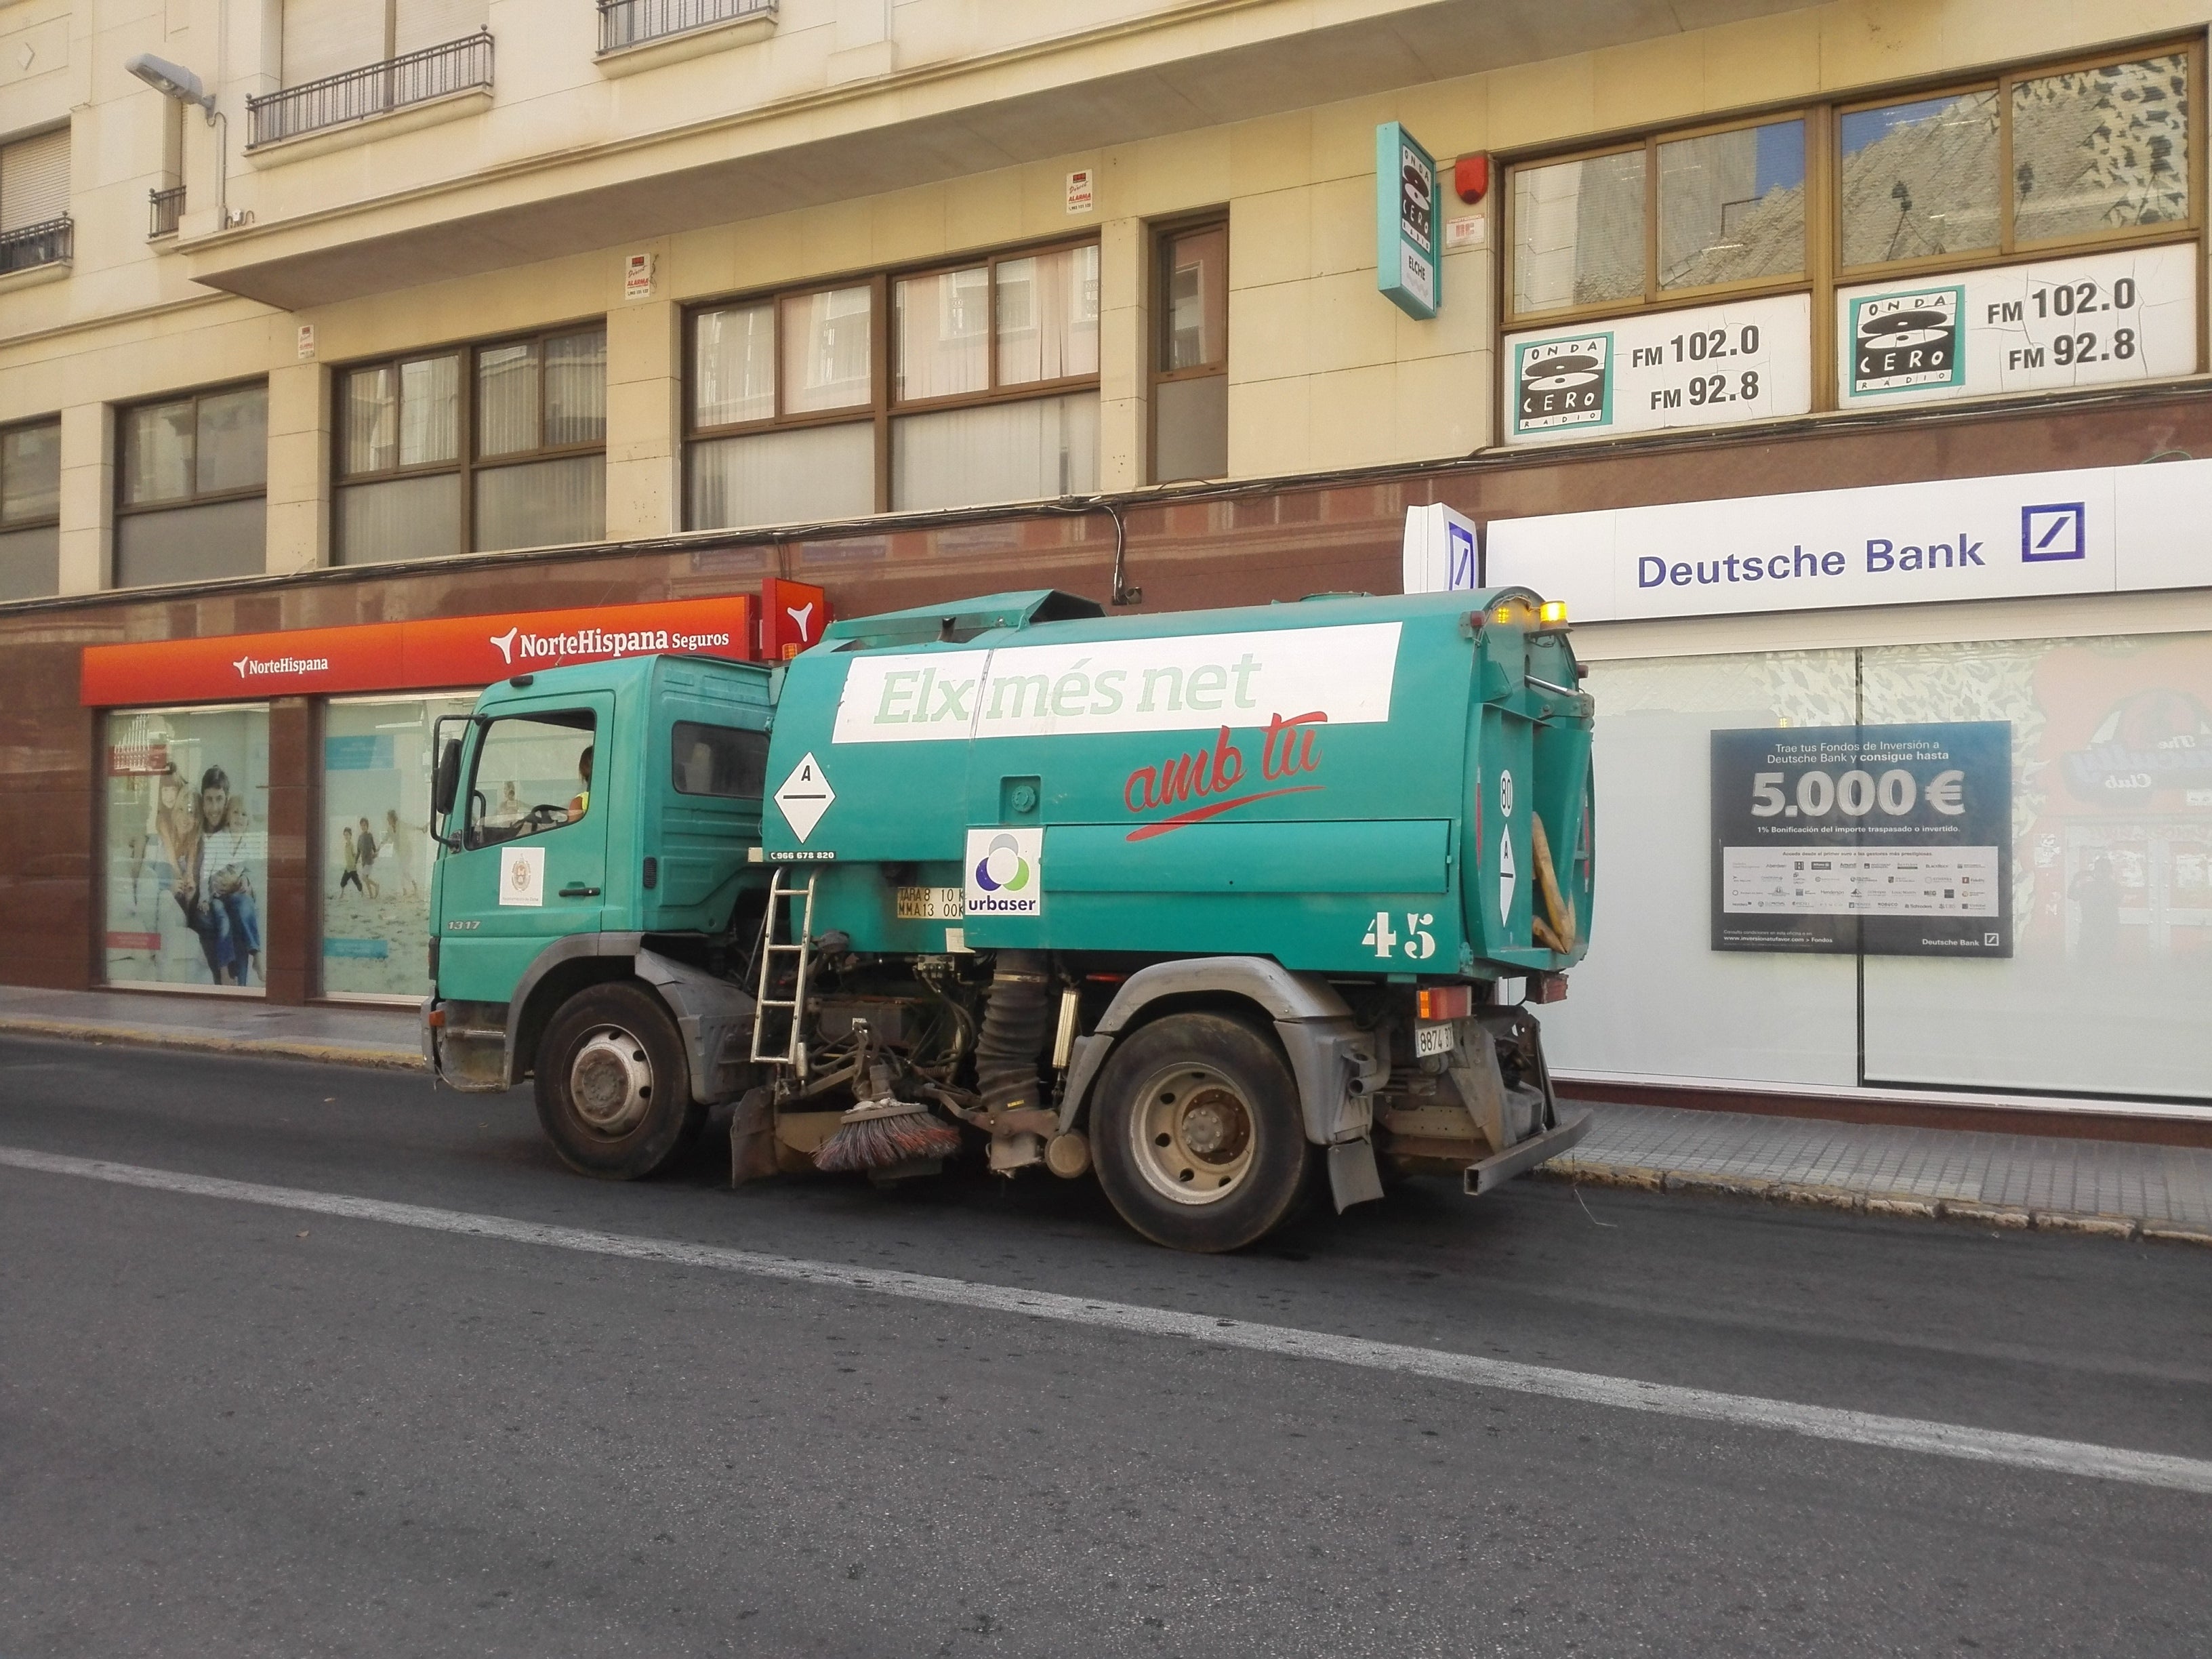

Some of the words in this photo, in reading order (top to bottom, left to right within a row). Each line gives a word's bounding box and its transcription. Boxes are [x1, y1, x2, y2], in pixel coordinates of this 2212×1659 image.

[1405, 150, 1429, 182] ONDA
[1069, 193, 1090, 201] ALARMA
[1404, 199, 1429, 234] CERO
[1403, 221, 1429, 249] RADIO
[1409, 255, 1425, 281] ELCHE
[627, 278, 649, 286] ALARMA
[1869, 295, 1946, 316] ONDA
[1988, 300, 2023, 324] FM
[2032, 278, 2135, 319] 102.0
[1531, 341, 1597, 361] ONDA
[1632, 346, 1662, 368] FM
[1671, 325, 1759, 363] 102.0
[2009, 348, 2045, 371] FM
[2053, 328, 2135, 365] 92.8
[1860, 350, 1944, 373] CERO
[1650, 389, 1681, 410] FM
[1689, 371, 1759, 407] 92.8
[1862, 371, 1946, 390] RADIO
[1523, 392, 1595, 413] CERO
[1524, 412, 1596, 428] RADIO
[1638, 544, 1845, 588] Deutsche
[1866, 533, 1986, 573] Bank
[520, 628, 668, 657] NorteHispana
[672, 632, 729, 651] Seguros
[249, 657, 328, 674] NorteHispana
[873, 667, 975, 724] Elx
[985, 657, 1127, 719] més
[1136, 653, 1262, 713] net
[1767, 754, 1817, 763] Deutsche
[1820, 753, 1847, 762] Bank
[1850, 755, 1857, 763] y
[1860, 752, 1913, 763] consigue
[1917, 751, 1948, 760] hasta
[1775, 744, 1797, 752] Trae
[1801, 744, 1817, 752] tus
[1820, 742, 1860, 752] Fondos
[1863, 742, 1877, 750] de
[1880, 740, 1929, 750] Inversión
[801, 765, 811, 781] A
[1124, 724, 1248, 813] amb
[1260, 711, 1328, 781] tu
[1502, 777, 1511, 809] 80
[1751, 769, 1917, 817] 5.000
[1925, 770, 1965, 815] €
[1504, 840, 1508, 859] A
[899, 888, 922, 901] TARA
[968, 895, 1036, 910] urbaser
[449, 921, 480, 929] 1317
[1361, 912, 1435, 959] 45
[1420, 1030, 1442, 1052] 8874
